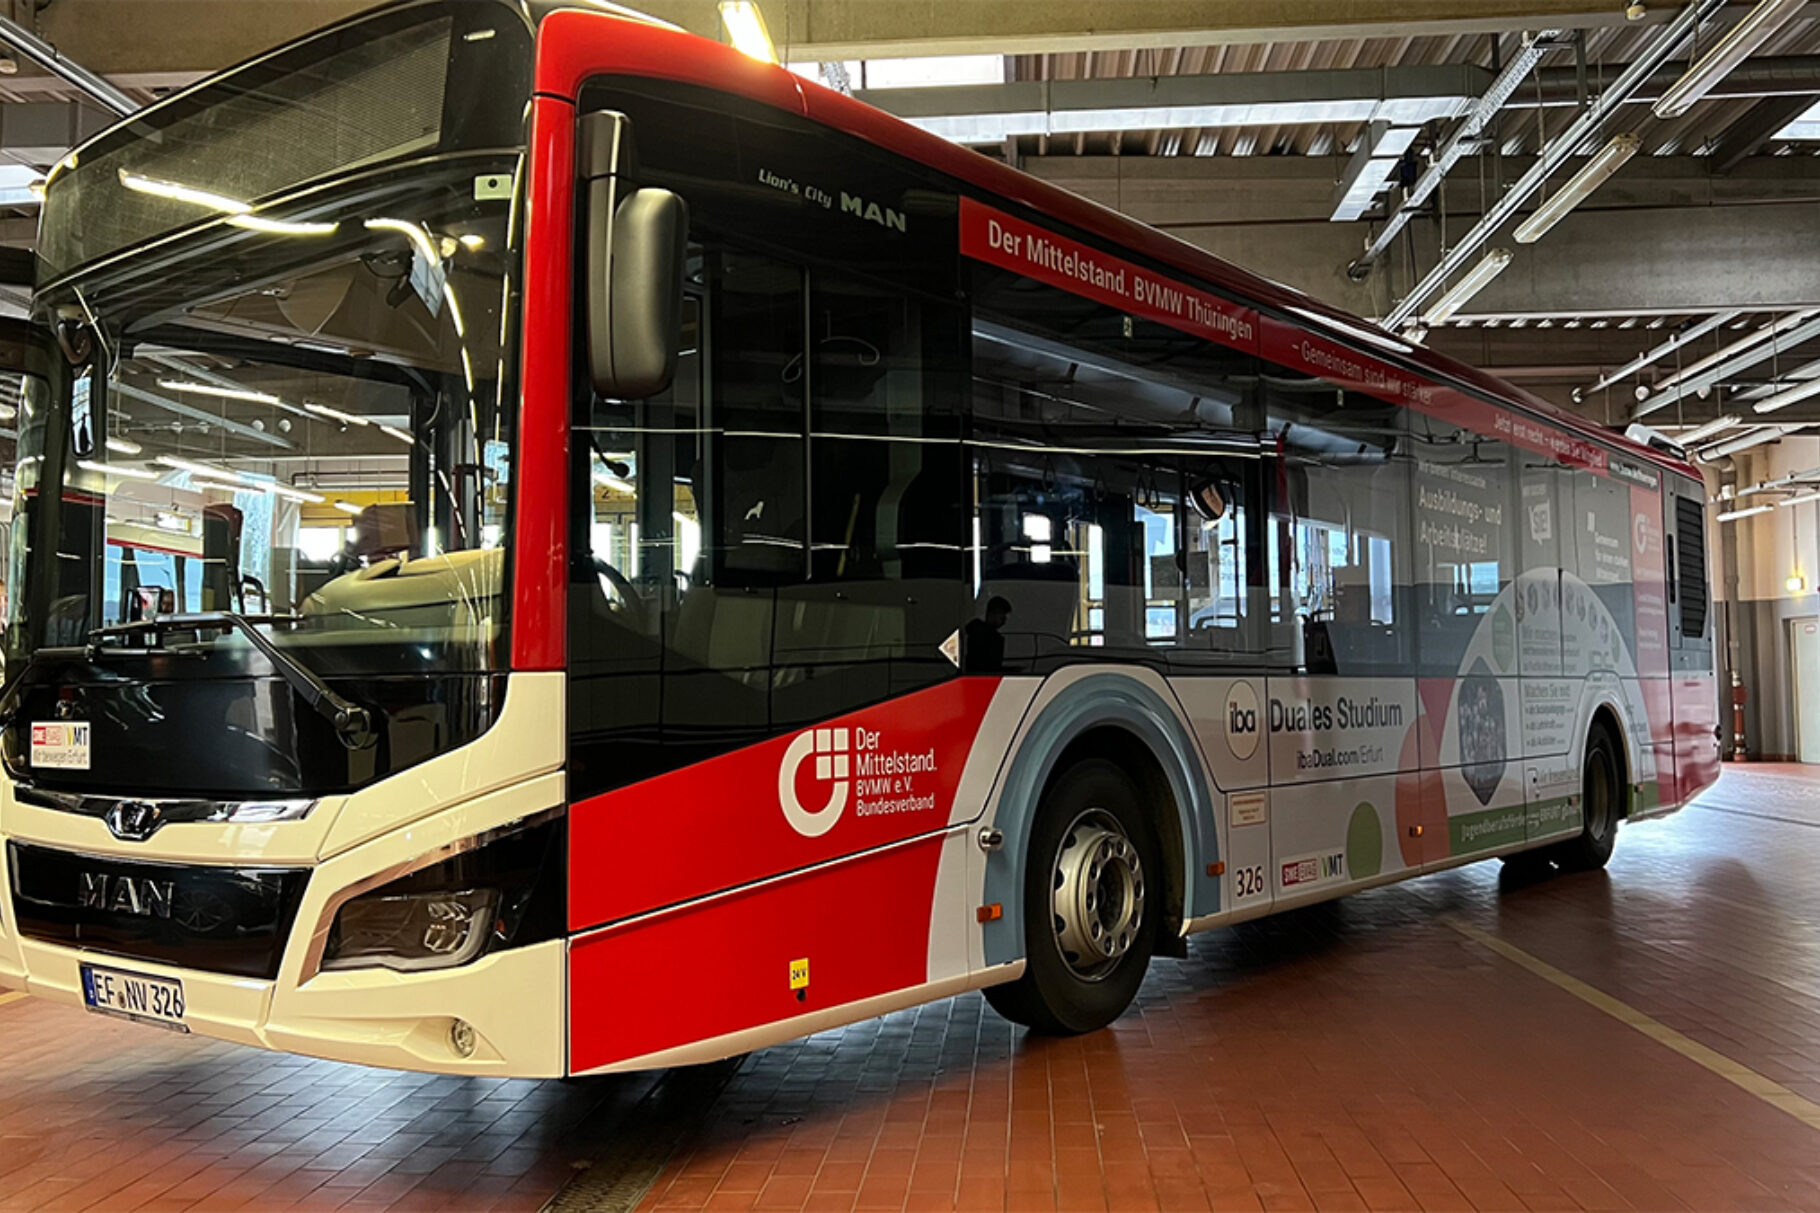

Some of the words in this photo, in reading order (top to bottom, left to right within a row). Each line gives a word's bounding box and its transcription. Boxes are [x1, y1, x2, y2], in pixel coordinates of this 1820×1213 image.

[758, 168, 799, 194] Lion's
[805, 185, 832, 209] City
[840, 191, 906, 232] MAN
[988, 219, 1021, 257] Der
[1026, 234, 1130, 297] Mittelstand.
[1134, 277, 1184, 315] BVMW
[1186, 295, 1252, 341] Thüringen
[1301, 340, 1363, 381] Gemeinsam
[1418, 485, 1483, 524] Ausbildungs-
[1484, 503, 1502, 525] und
[1229, 701, 1256, 734] iba
[1270, 698, 1333, 733] Duales
[1336, 697, 1403, 729] Studium
[67, 726, 88, 746] VMT
[855, 726, 880, 750] Der
[856, 747, 938, 777] Mittelstand.
[1297, 749, 1359, 770] ibaDual.com
[1360, 745, 1384, 765] Erfurt
[856, 777, 891, 796] BVMW
[856, 793, 935, 816] Bundesverband
[1236, 865, 1263, 898] 326
[1321, 853, 1344, 878] VMT
[79, 872, 175, 919] MAN
[94, 973, 115, 1005] EF
[124, 978, 148, 1013] NV
[150, 984, 185, 1019] 326
